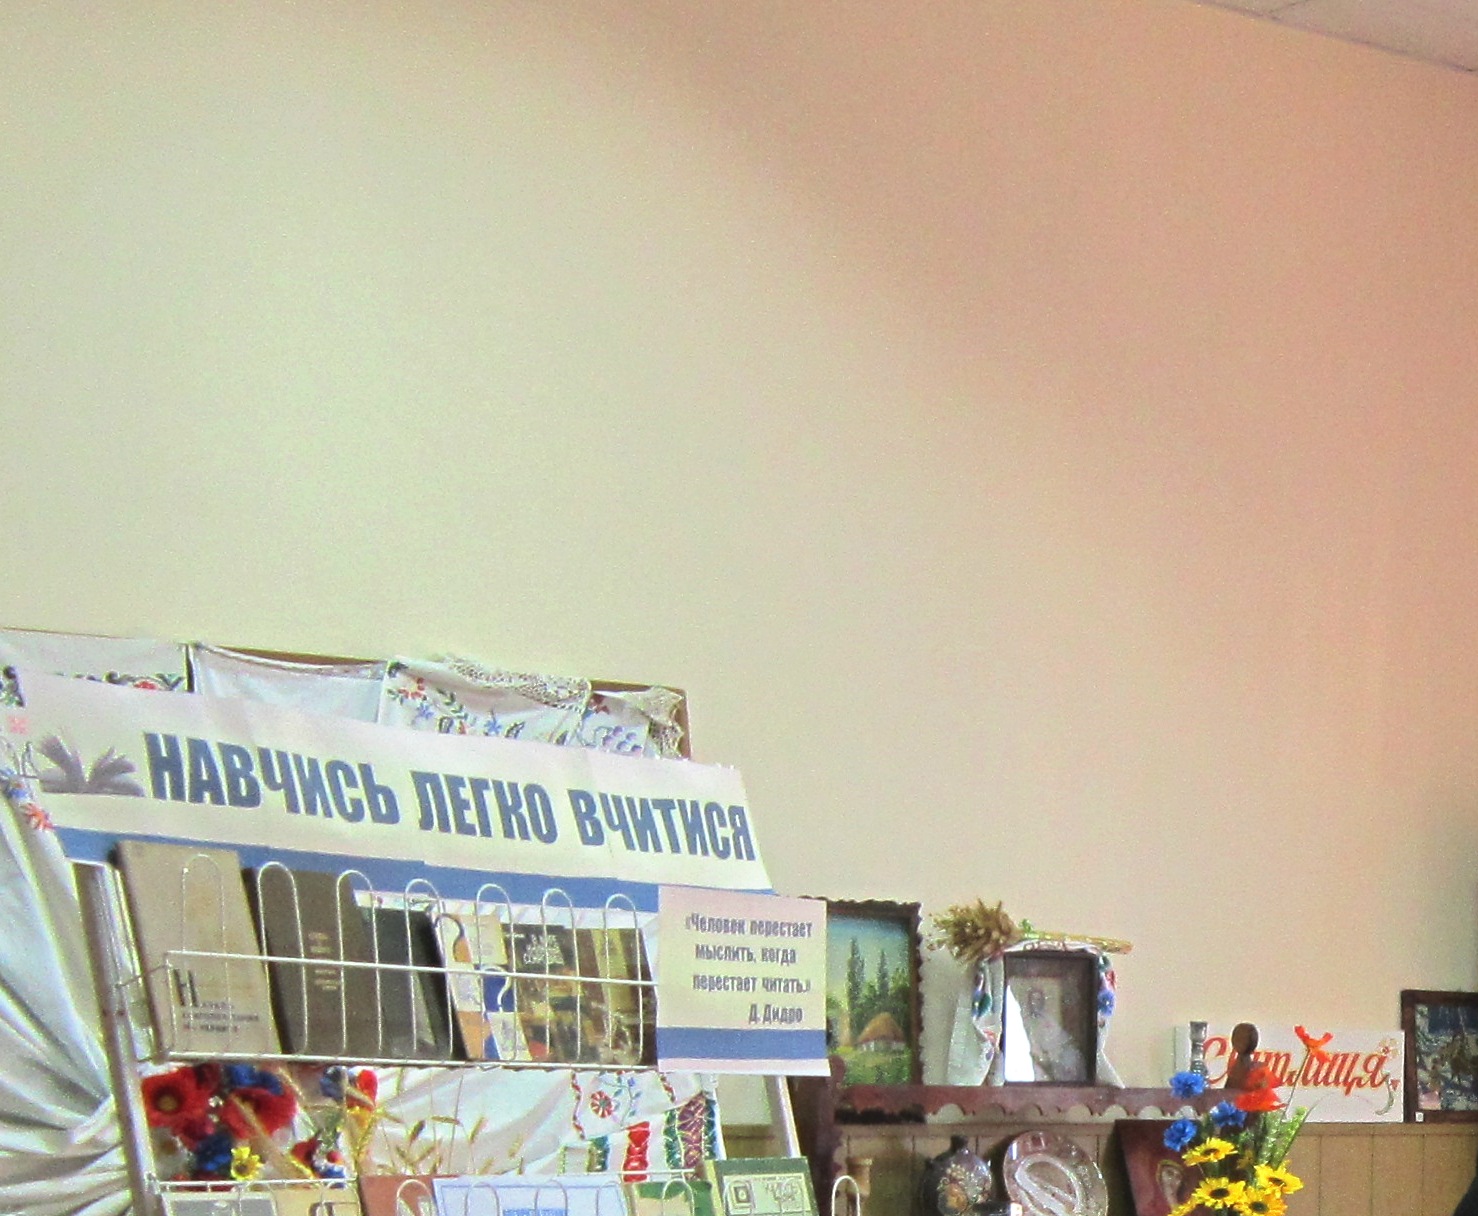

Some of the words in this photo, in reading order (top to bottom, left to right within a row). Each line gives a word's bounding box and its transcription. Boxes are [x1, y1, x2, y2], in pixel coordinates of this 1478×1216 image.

[144, 732, 400, 824] НАВЧИСЬ
[410, 770, 558, 844] ЛЕГКО
[567, 789, 756, 861] ВЧИТИСЯ
[750, 919, 813, 938] перестает
[761, 948, 797, 966] когда
[692, 974, 758, 992] перестает
[763, 1004, 803, 1025] Дидро
